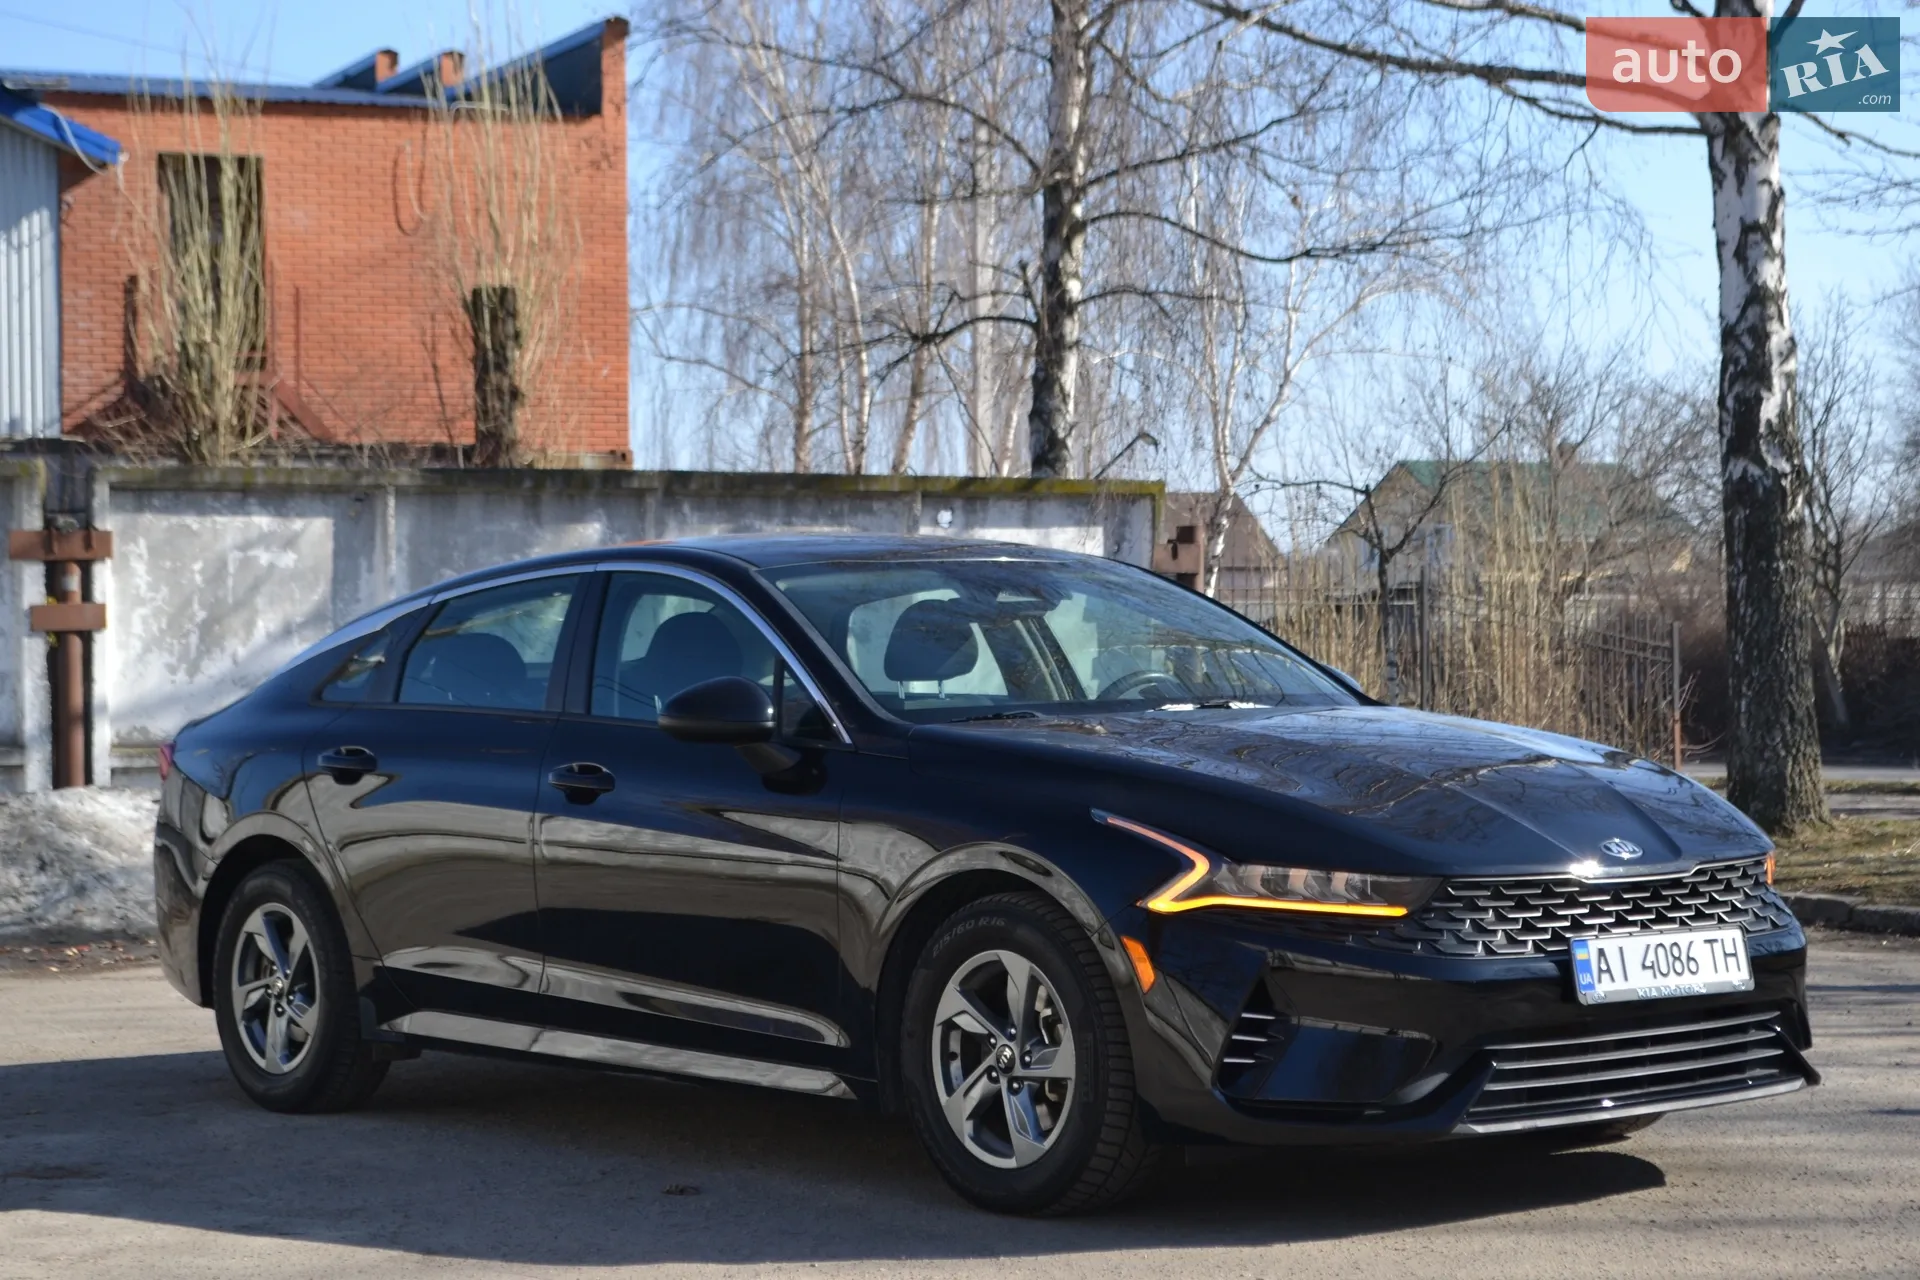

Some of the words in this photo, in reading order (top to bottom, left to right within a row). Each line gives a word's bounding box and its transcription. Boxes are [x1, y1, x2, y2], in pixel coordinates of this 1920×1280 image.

[1597, 946, 1628, 984] AI
[1641, 940, 1699, 979] 4086
[1703, 937, 1741, 974] TH
[1579, 972, 1593, 985] UA
[1636, 987, 1659, 1000] KIA
